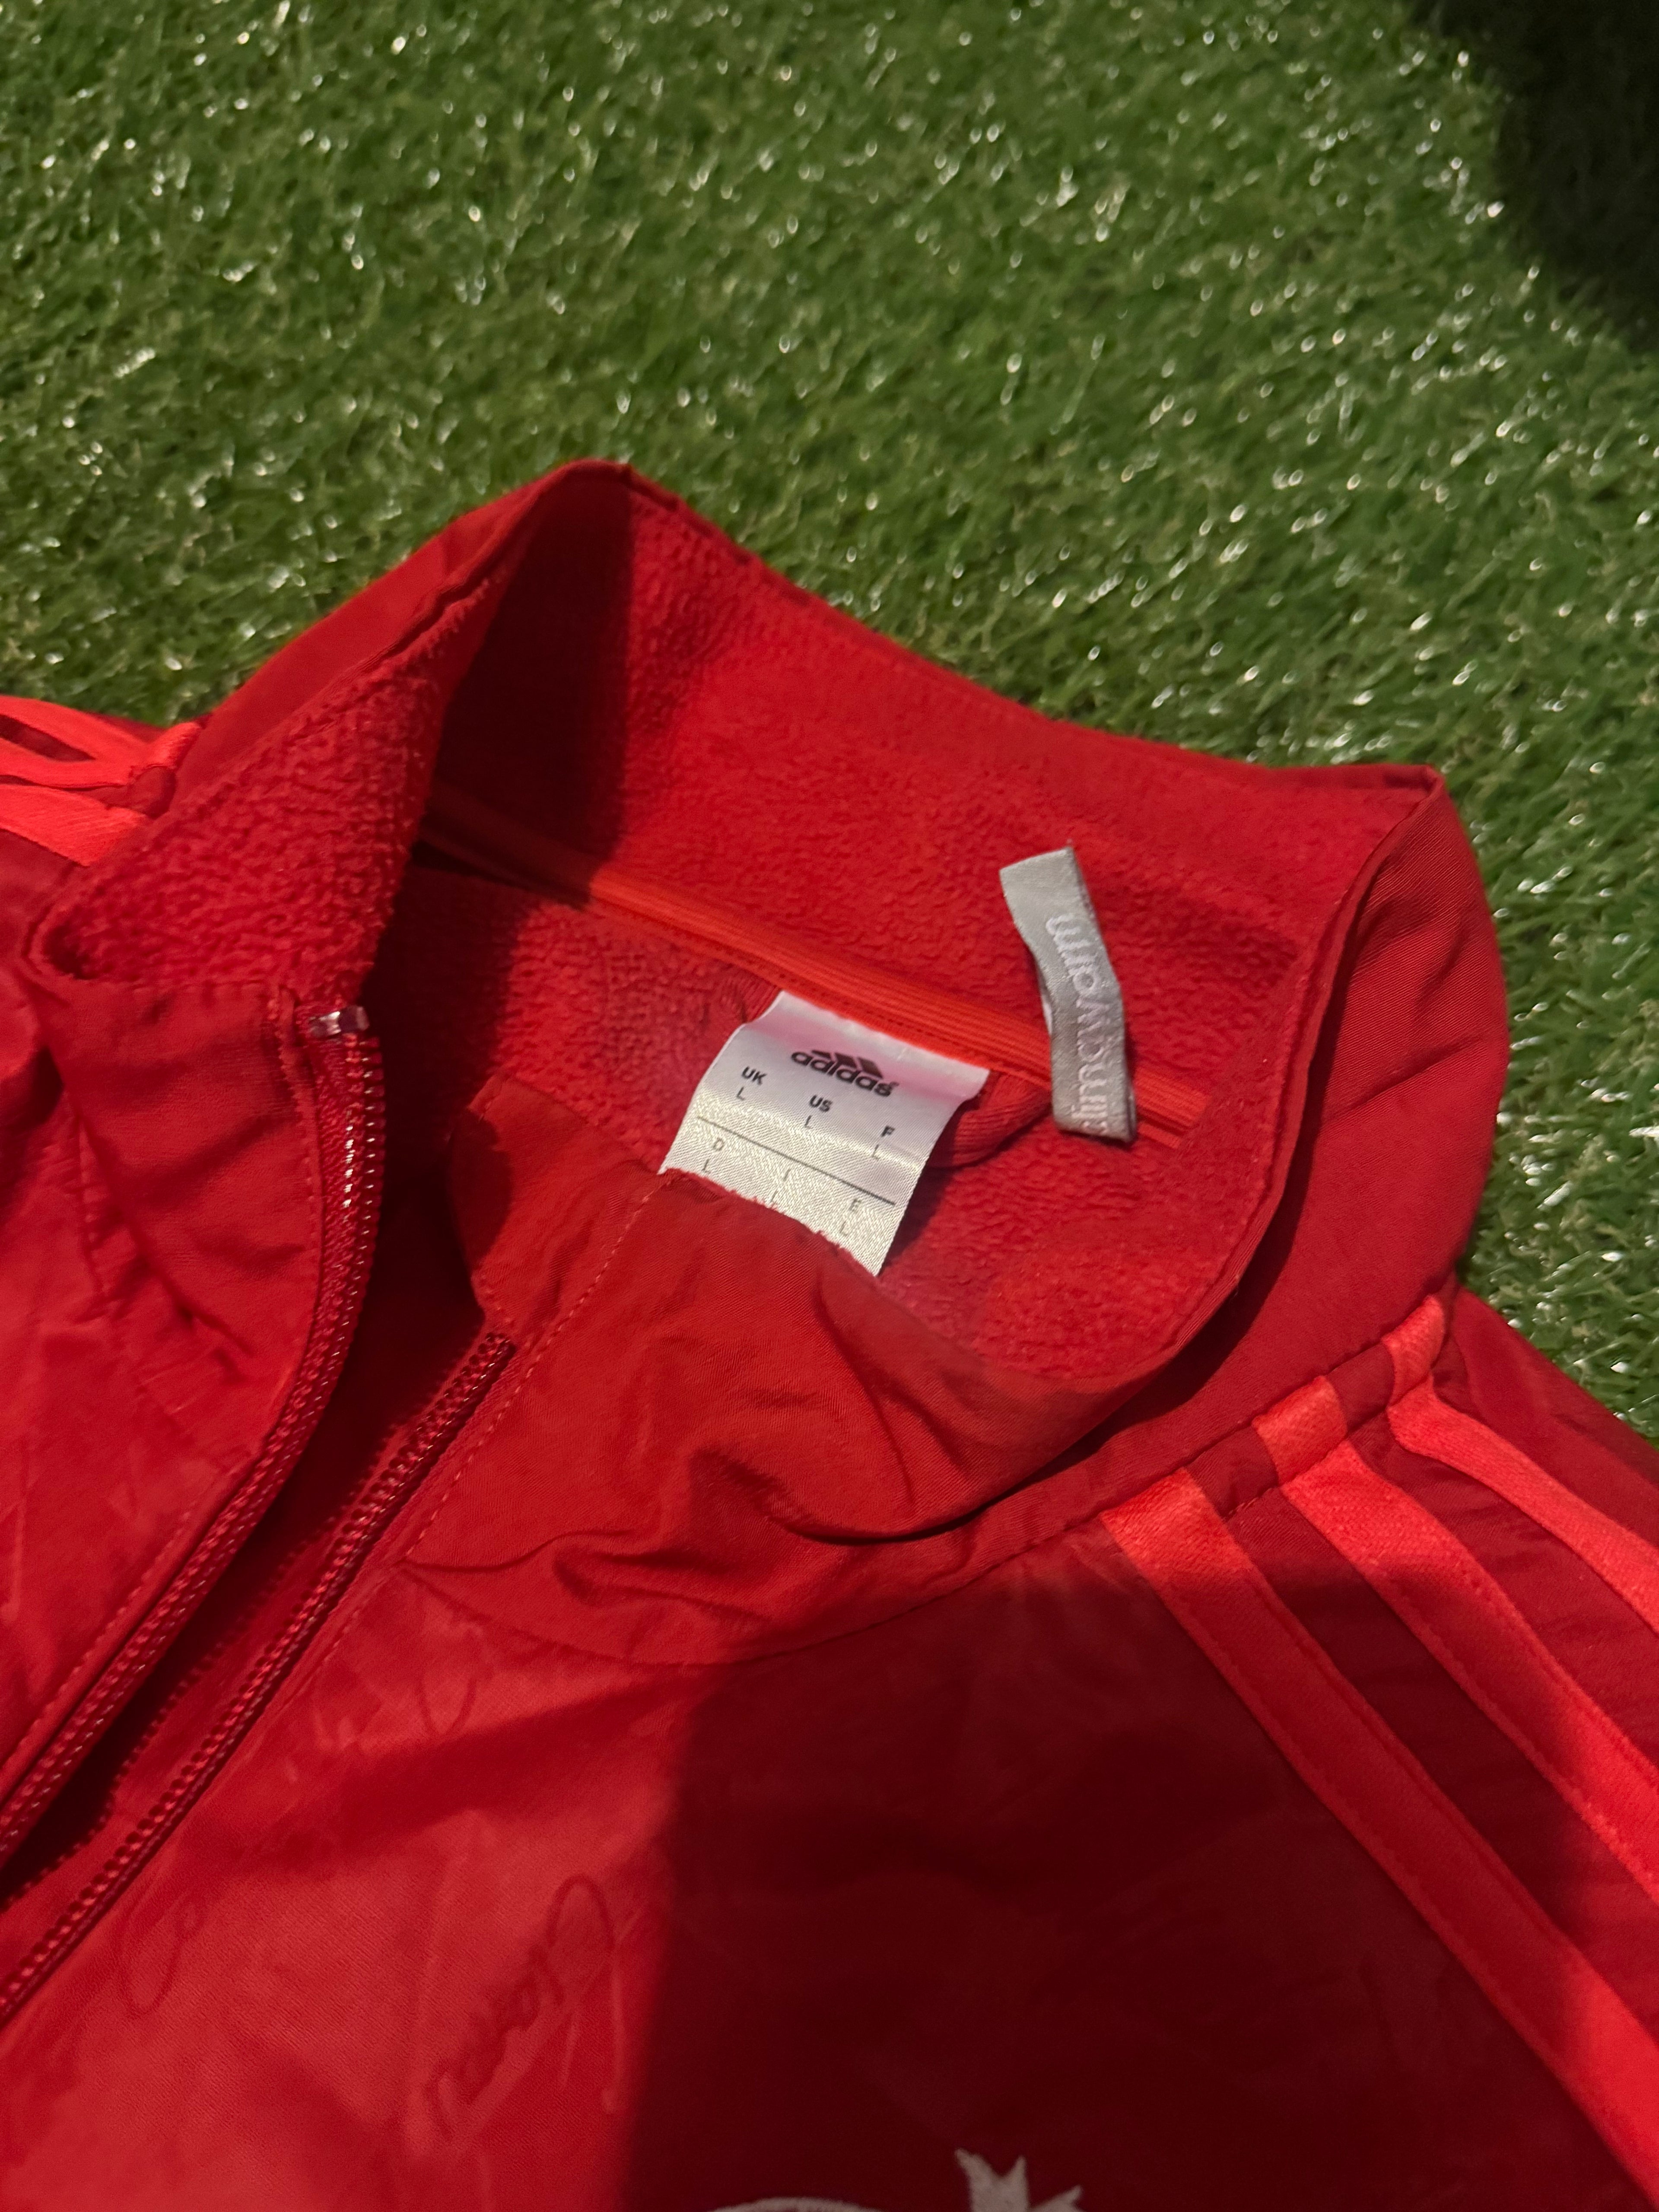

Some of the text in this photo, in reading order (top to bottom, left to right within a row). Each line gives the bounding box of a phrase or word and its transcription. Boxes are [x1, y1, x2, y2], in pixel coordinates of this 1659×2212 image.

[1046, 913, 1110, 1135] climawarm
[741, 1066, 895, 1138] UK US F
[791, 1051, 892, 1097] adidas
[736, 1087, 880, 1161] L L L
